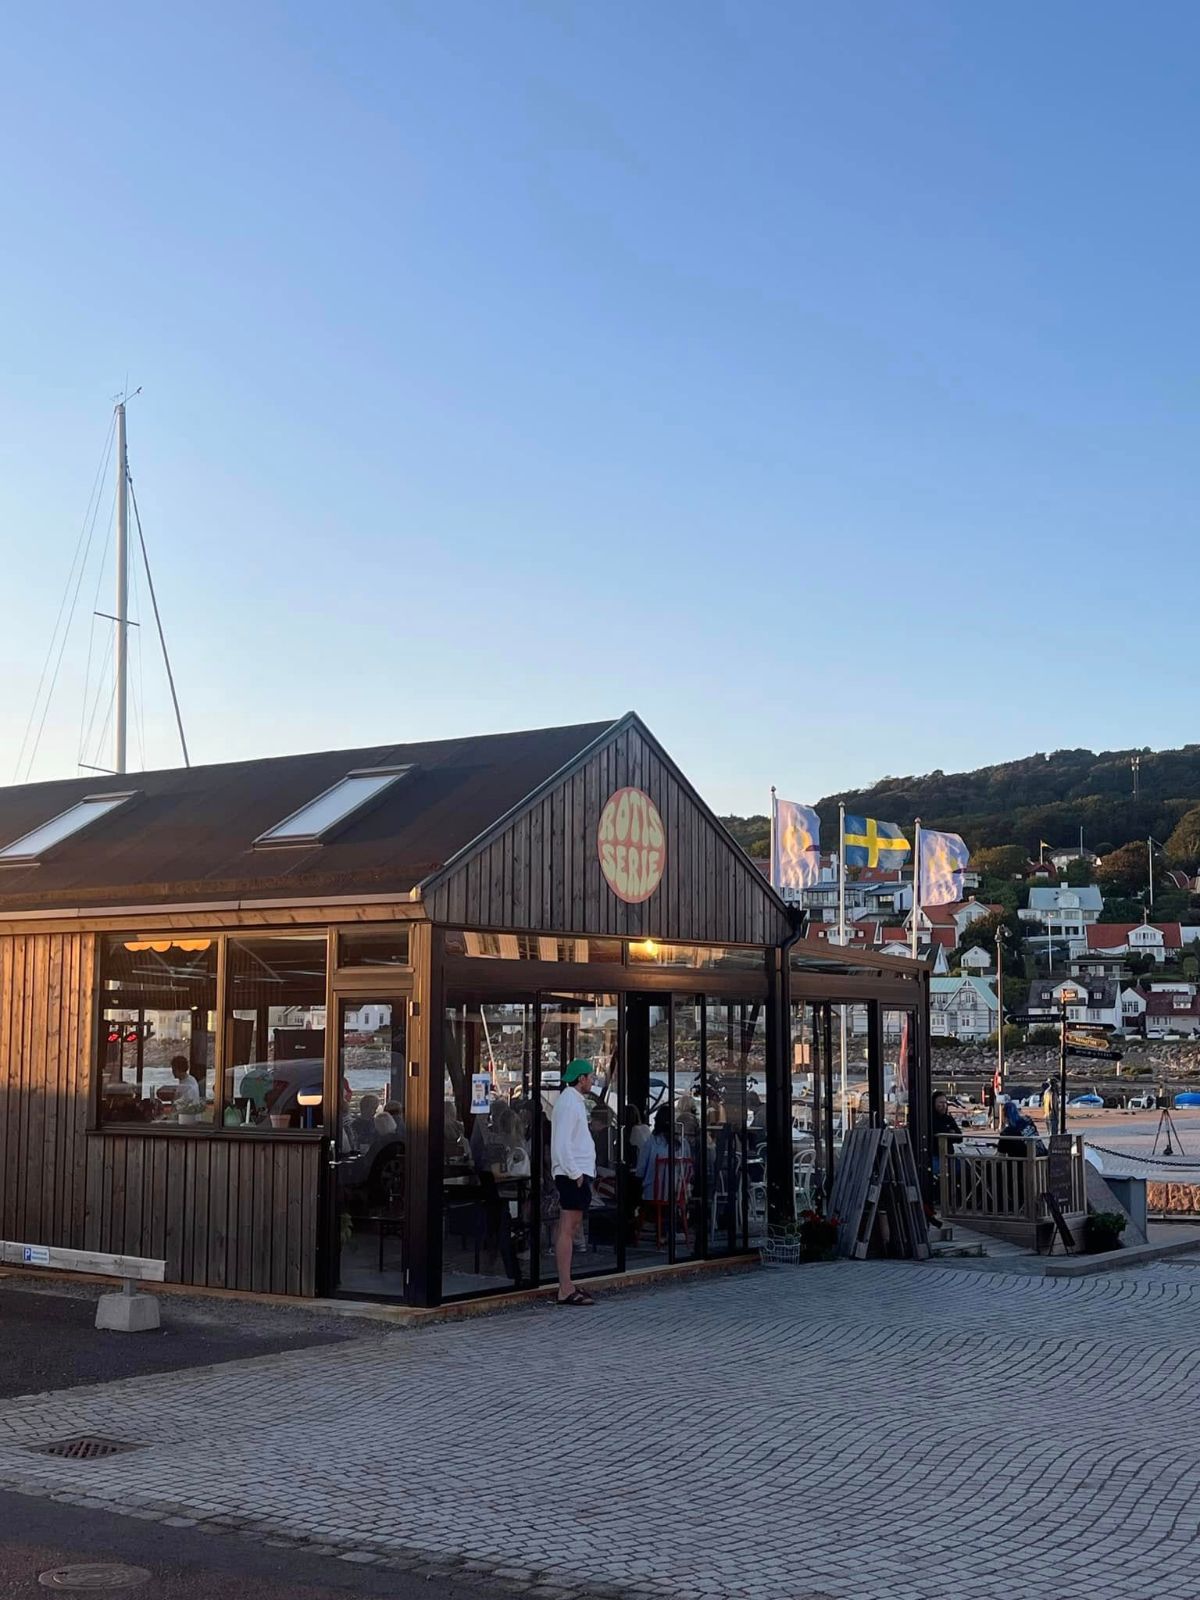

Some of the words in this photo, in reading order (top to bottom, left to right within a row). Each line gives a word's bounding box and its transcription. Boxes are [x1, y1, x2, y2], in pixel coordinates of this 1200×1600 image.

[600, 791, 662, 848] ROTIS
[602, 844, 660, 896] SERIE
[25, 1249, 31, 1260] P
